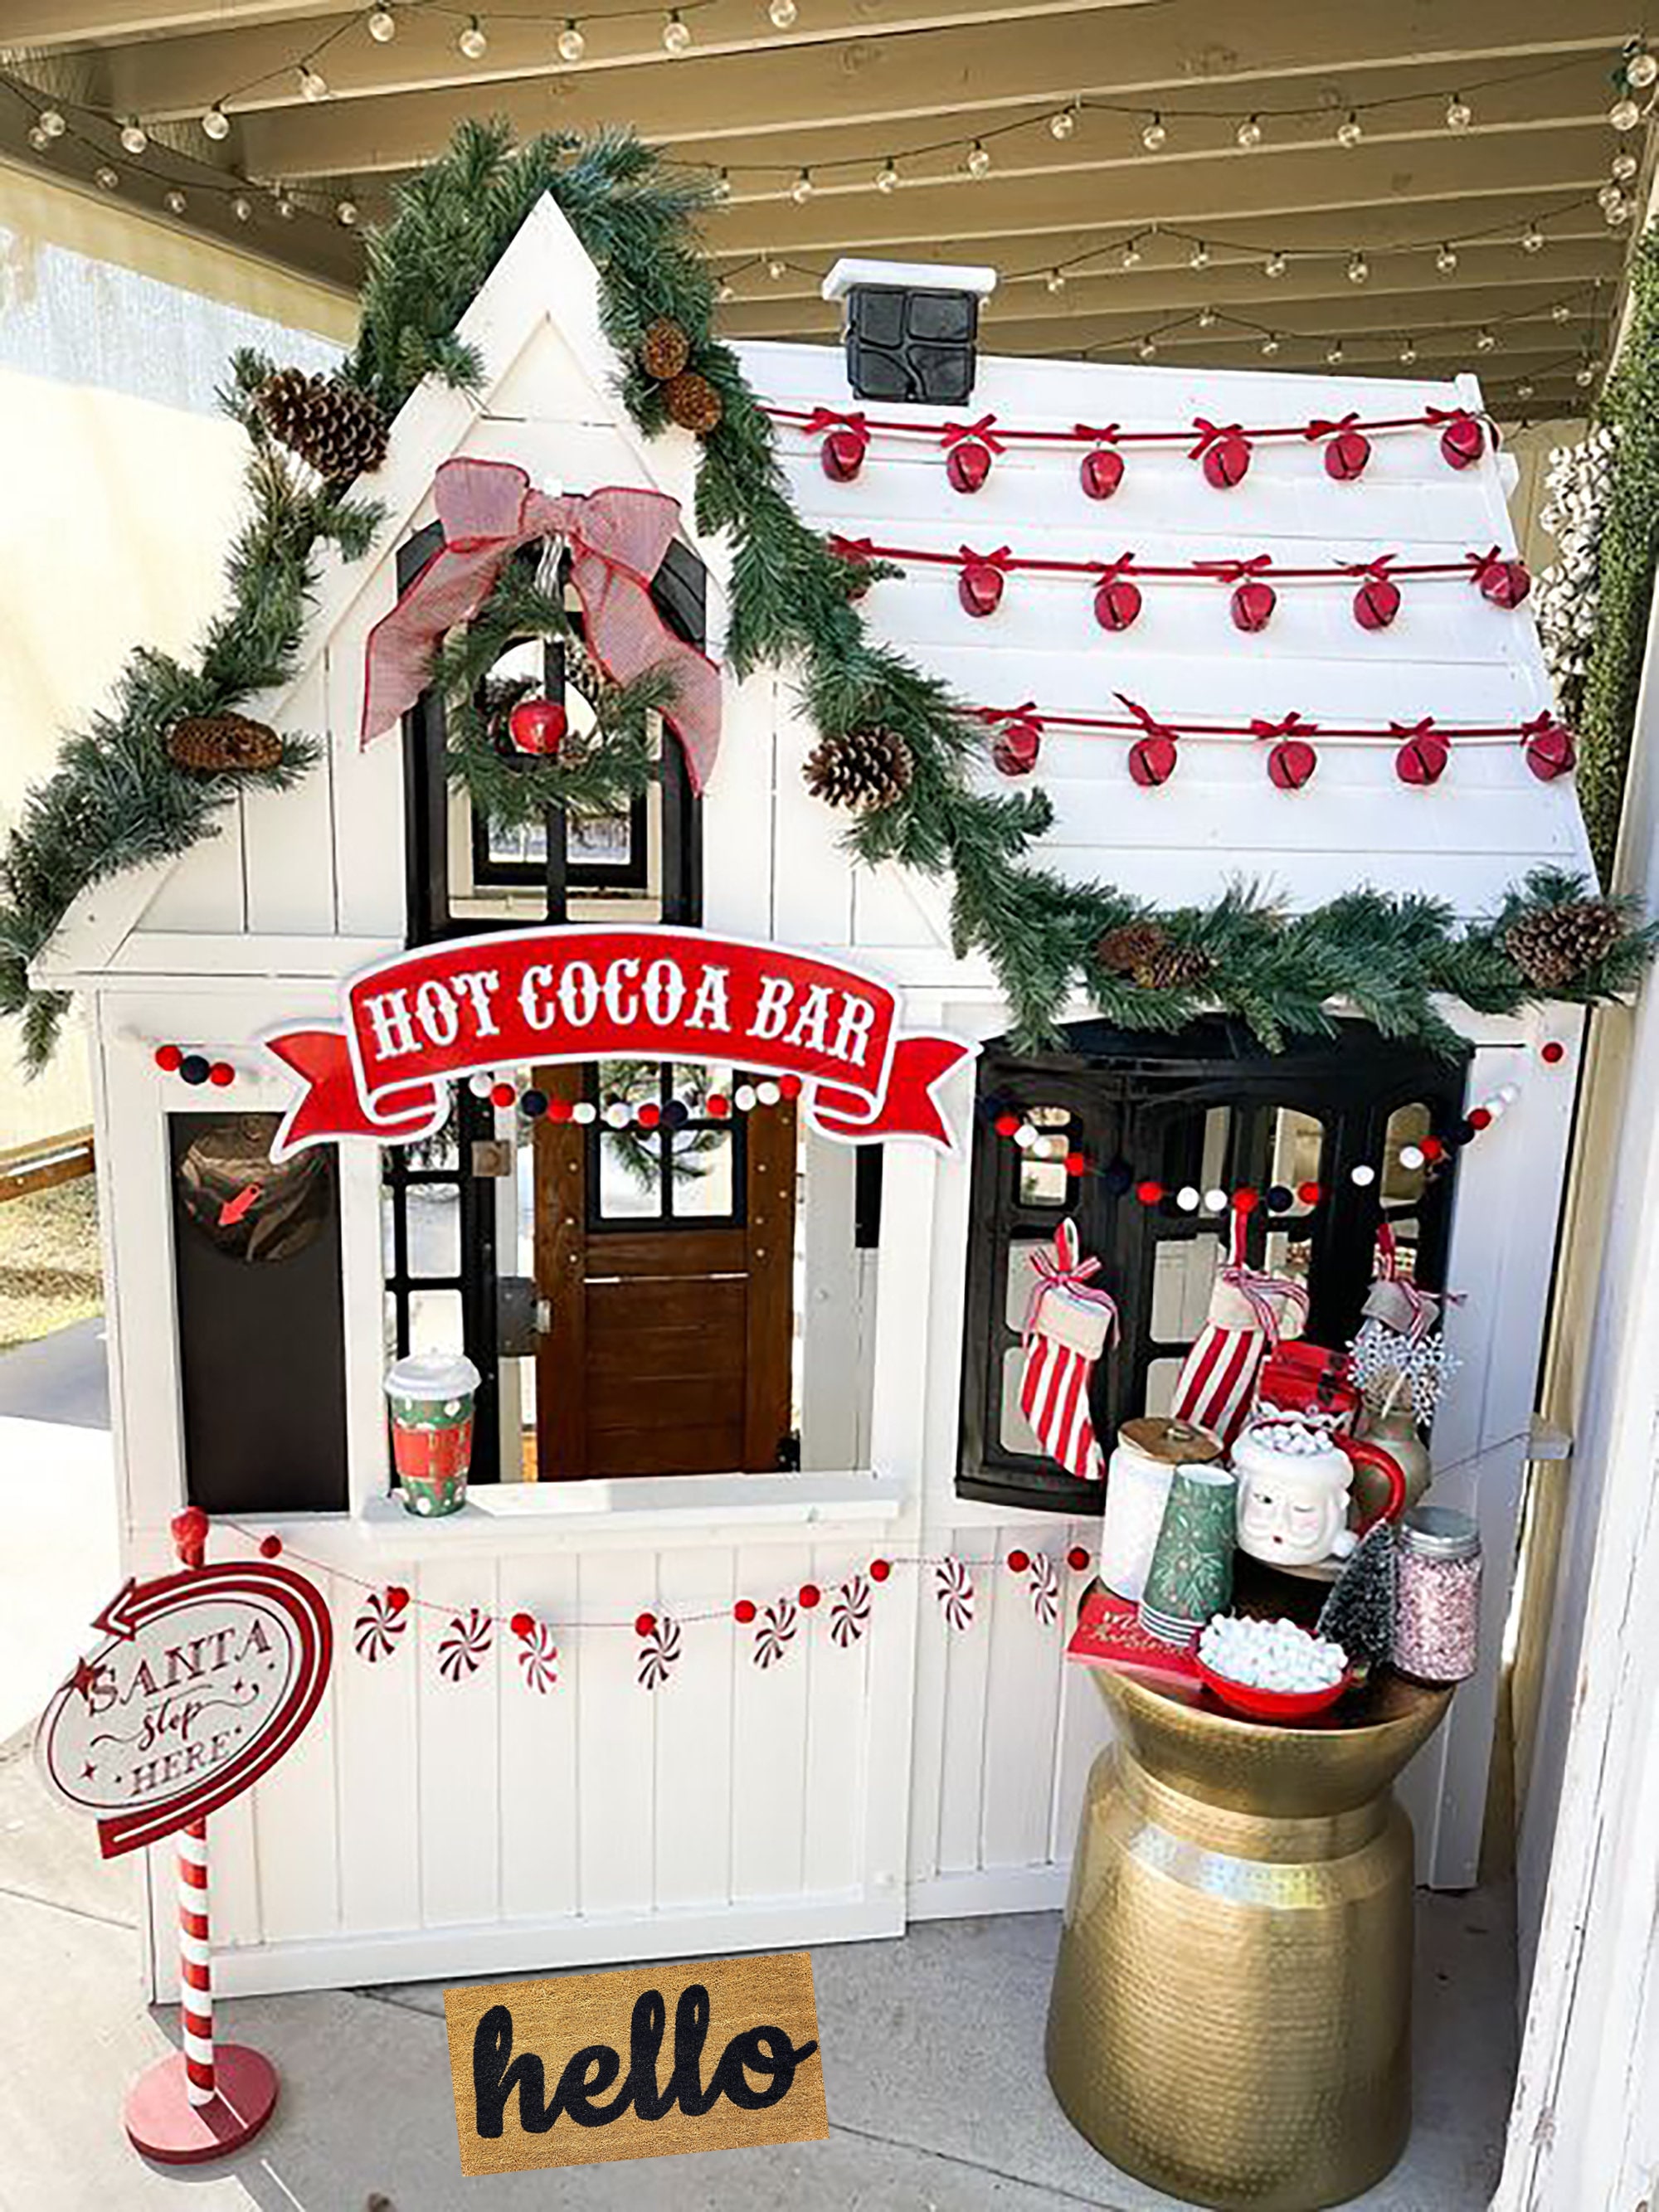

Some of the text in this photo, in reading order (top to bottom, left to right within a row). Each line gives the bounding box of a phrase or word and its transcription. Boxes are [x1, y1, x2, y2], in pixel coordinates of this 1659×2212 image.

[362, 957, 877, 1067] HOT COCOA BAR
[89, 1619, 272, 1718] SANTA
[129, 1731, 229, 1796] HERE
[473, 1983, 818, 2138] hello
